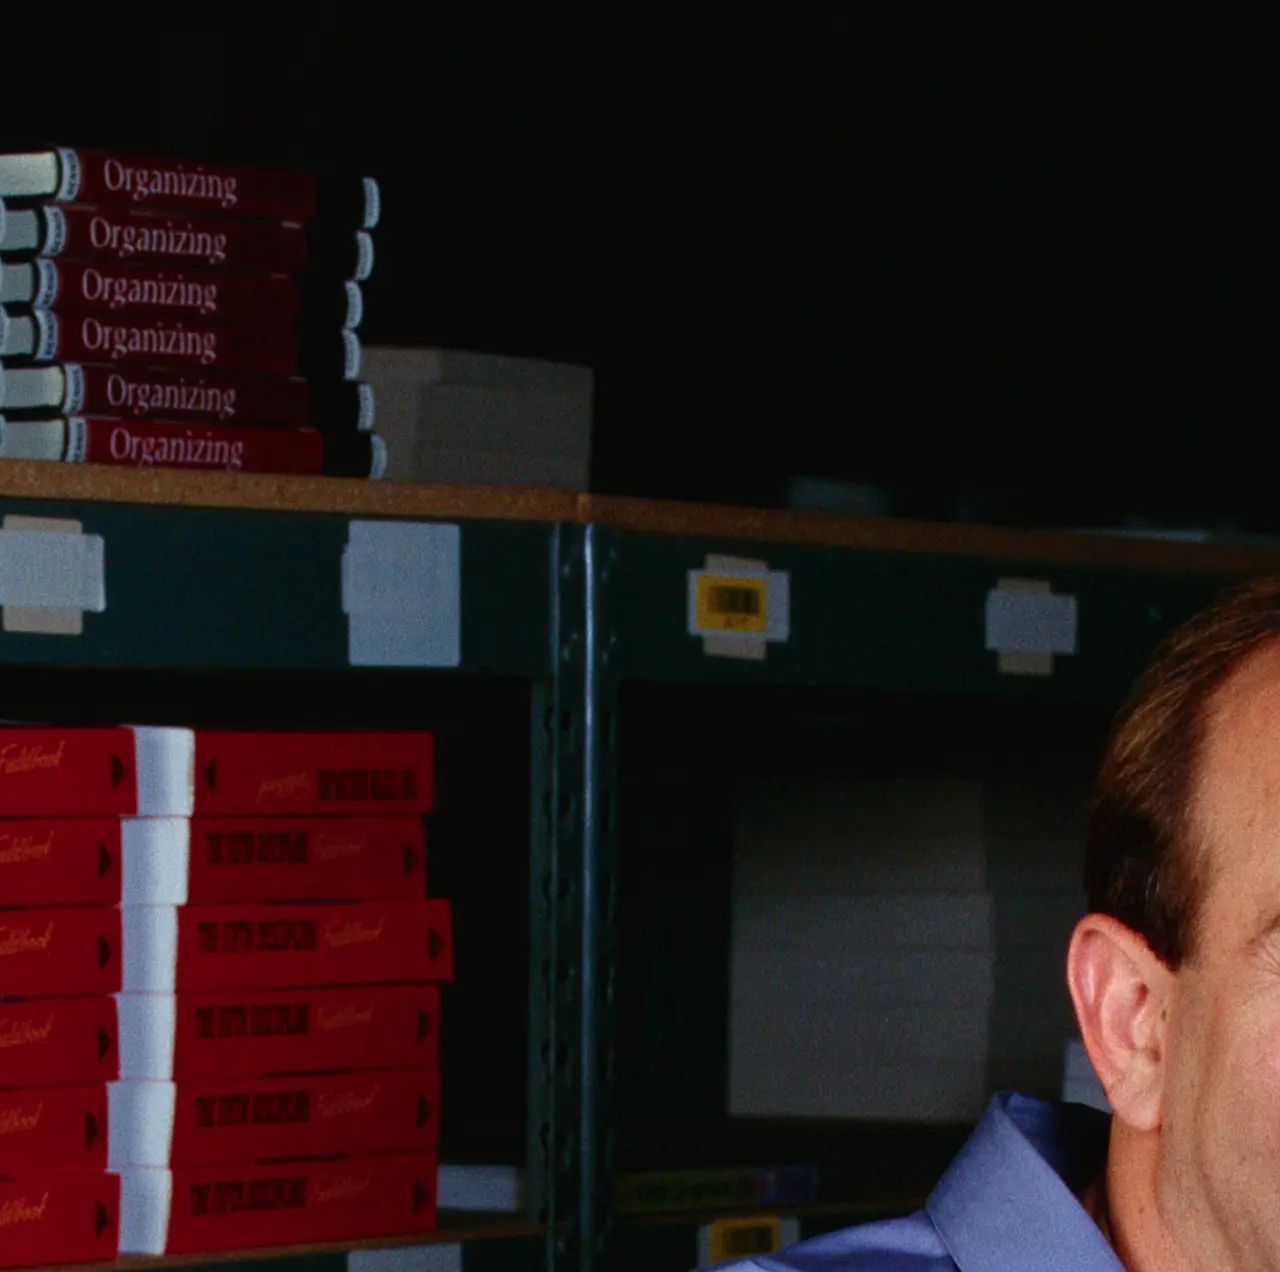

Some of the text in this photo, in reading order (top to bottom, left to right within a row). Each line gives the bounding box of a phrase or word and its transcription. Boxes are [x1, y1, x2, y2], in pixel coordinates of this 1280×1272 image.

[104, 160, 237, 207] Organizing
[90, 218, 226, 259] Organizing
[82, 271, 216, 313] Organizing
[82, 321, 216, 362] Organizing
[106, 377, 236, 417] Organizing
[109, 429, 243, 467] Organizing
